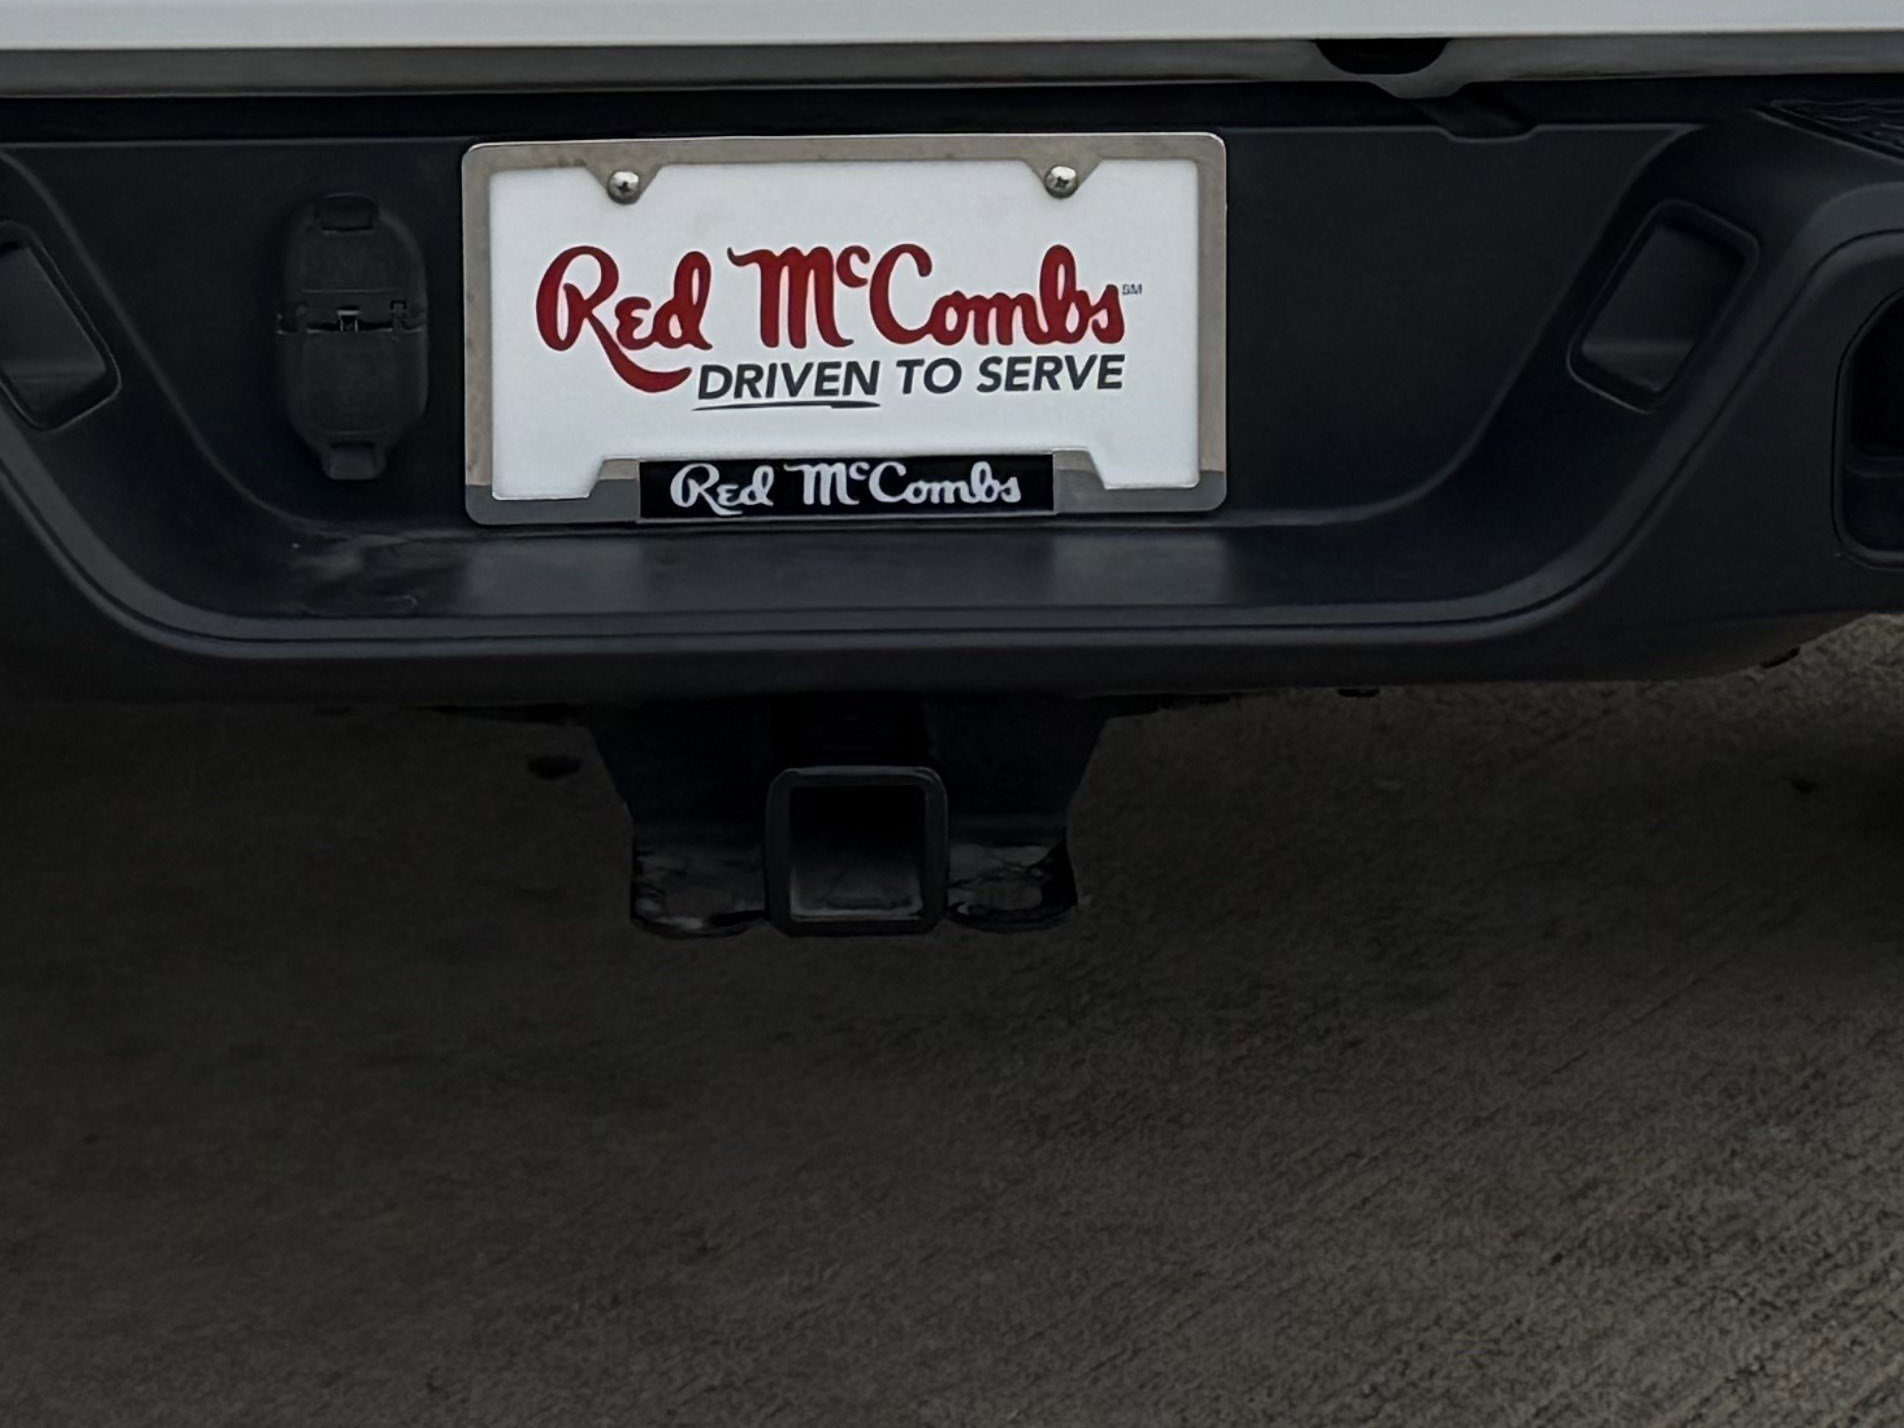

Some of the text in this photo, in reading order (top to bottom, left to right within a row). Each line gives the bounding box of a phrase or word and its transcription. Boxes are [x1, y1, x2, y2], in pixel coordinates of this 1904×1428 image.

[535, 244, 713, 393] Red
[727, 243, 1126, 350] McCombs
[698, 353, 1126, 401] DRIVEN TO SERVE
[669, 459, 1023, 515] Red McCombs
